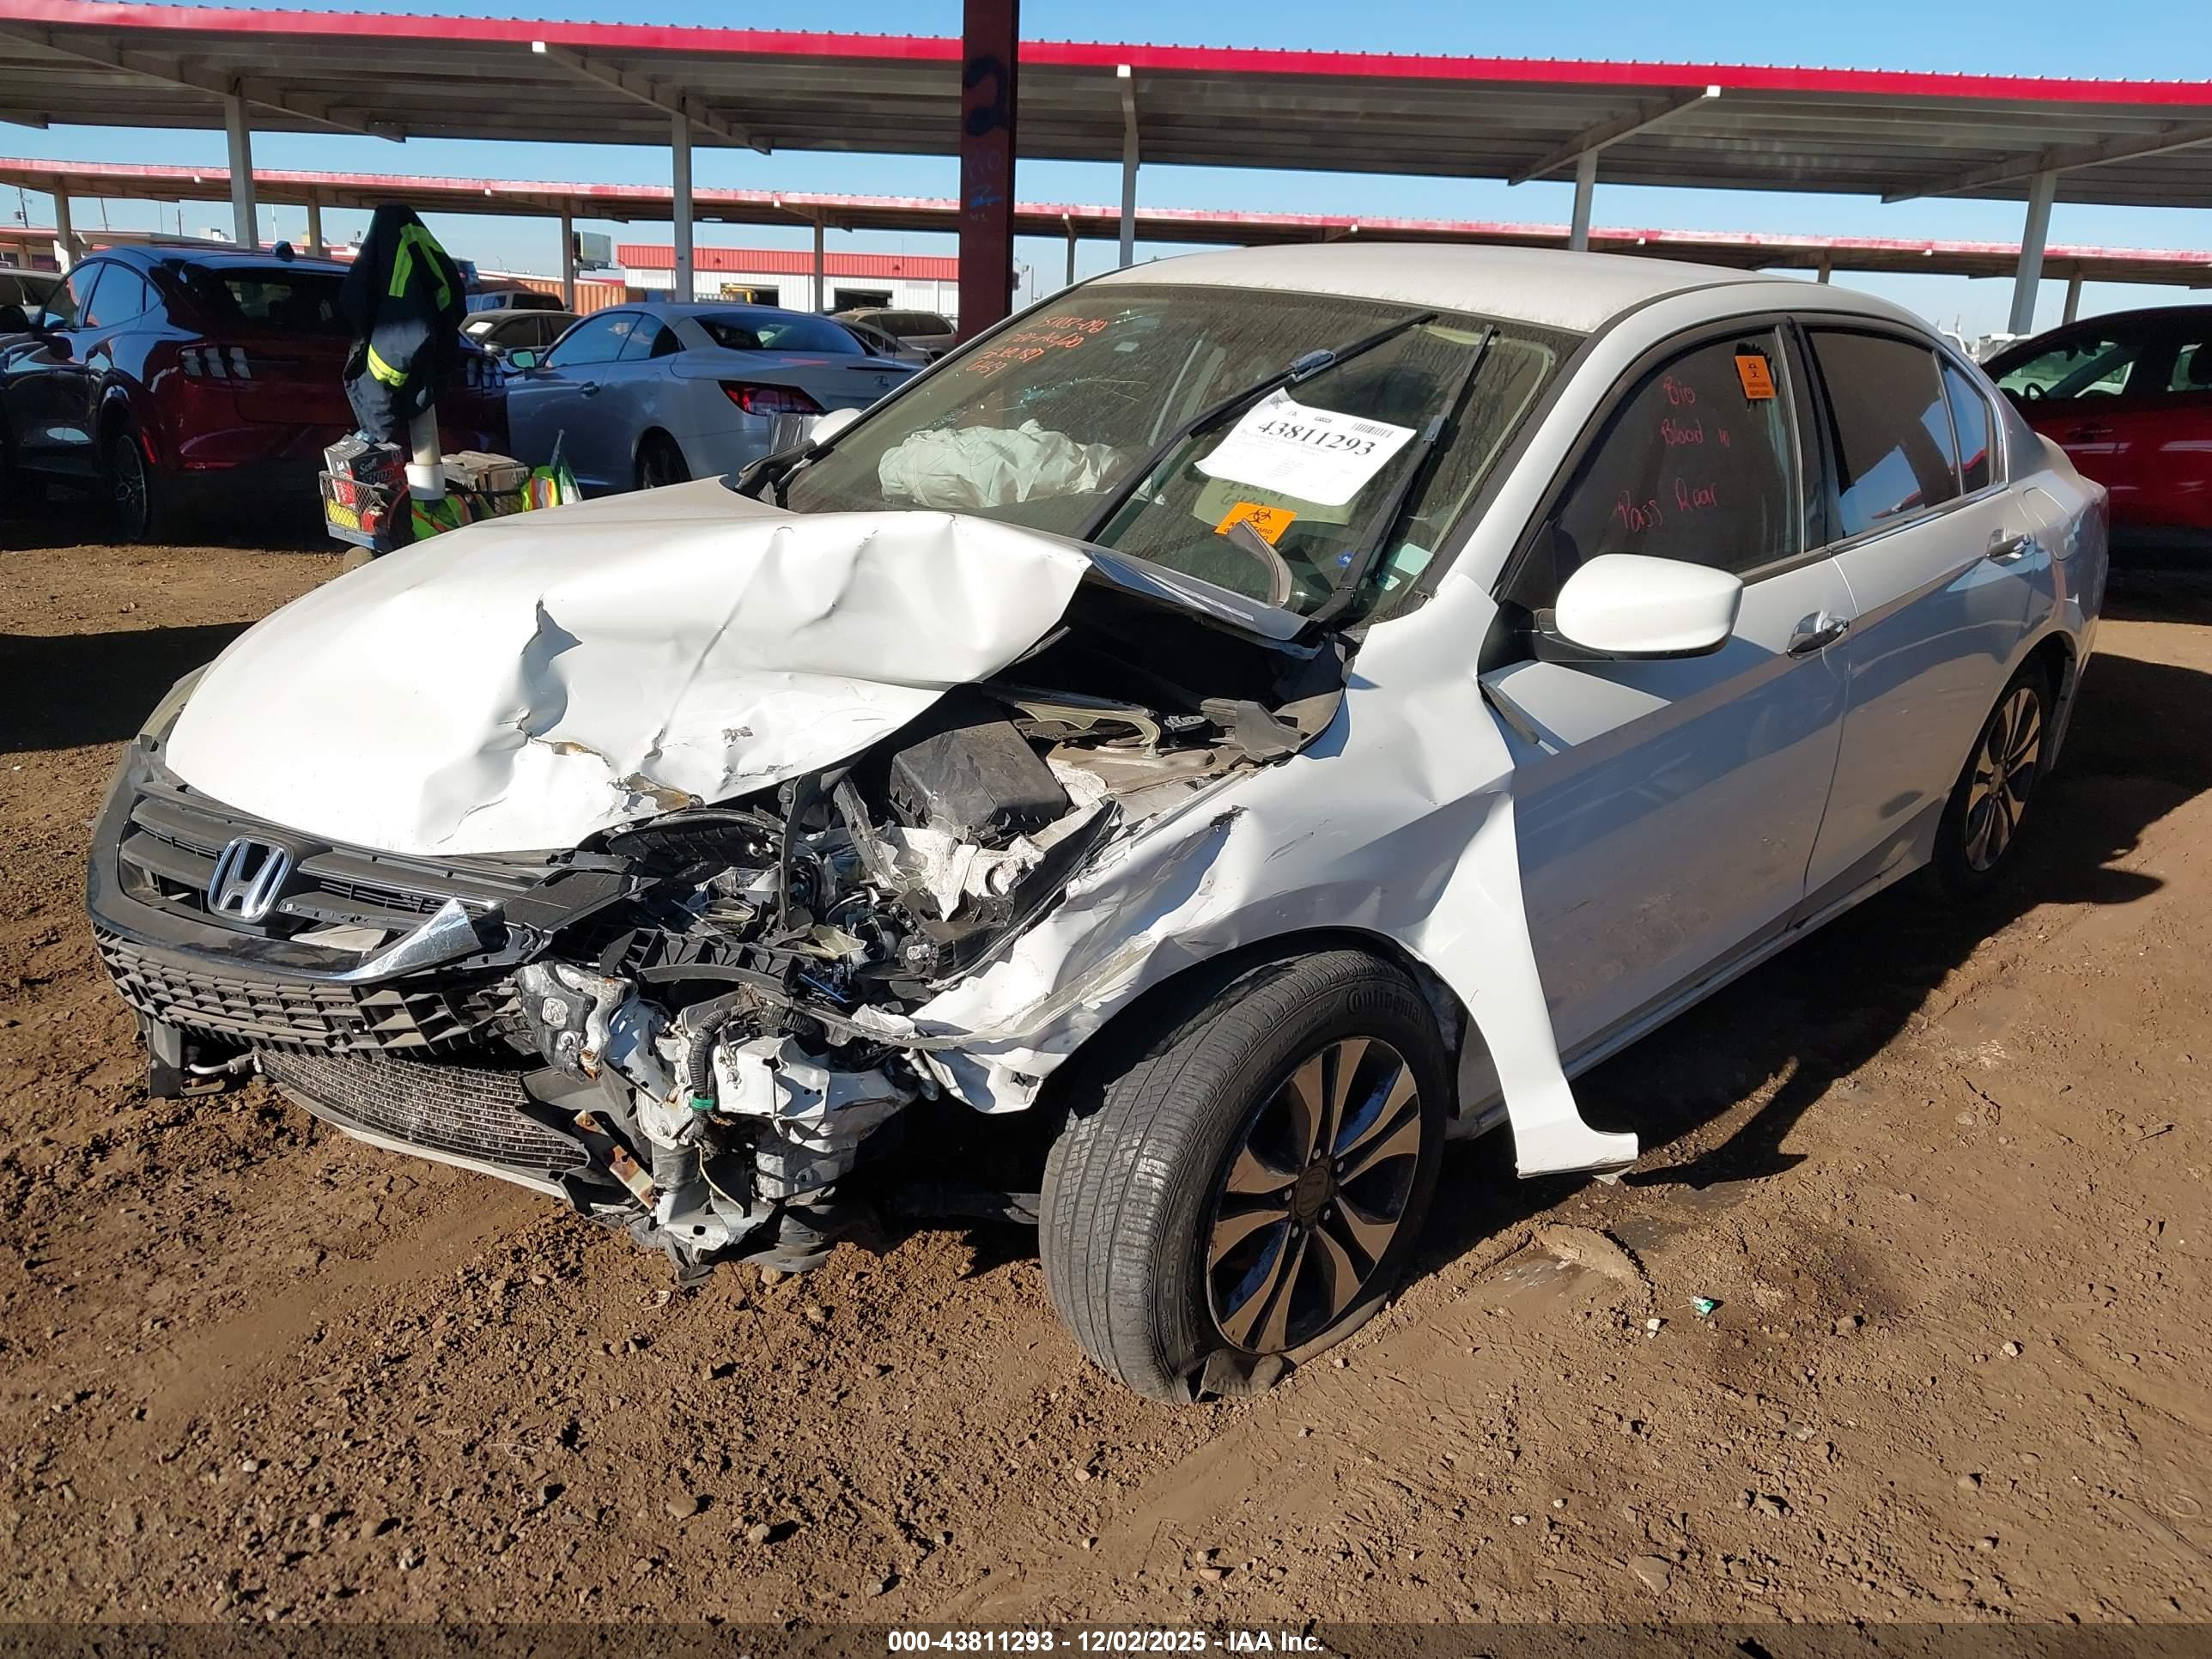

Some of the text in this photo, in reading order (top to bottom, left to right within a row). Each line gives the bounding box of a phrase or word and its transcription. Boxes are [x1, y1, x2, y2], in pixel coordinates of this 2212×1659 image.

[1663, 376, 1696, 405] Bio
[1258, 421, 1376, 456] 43811293
[1662, 418, 1704, 447] Blood
[1615, 477, 1717, 532] Pass Rear
